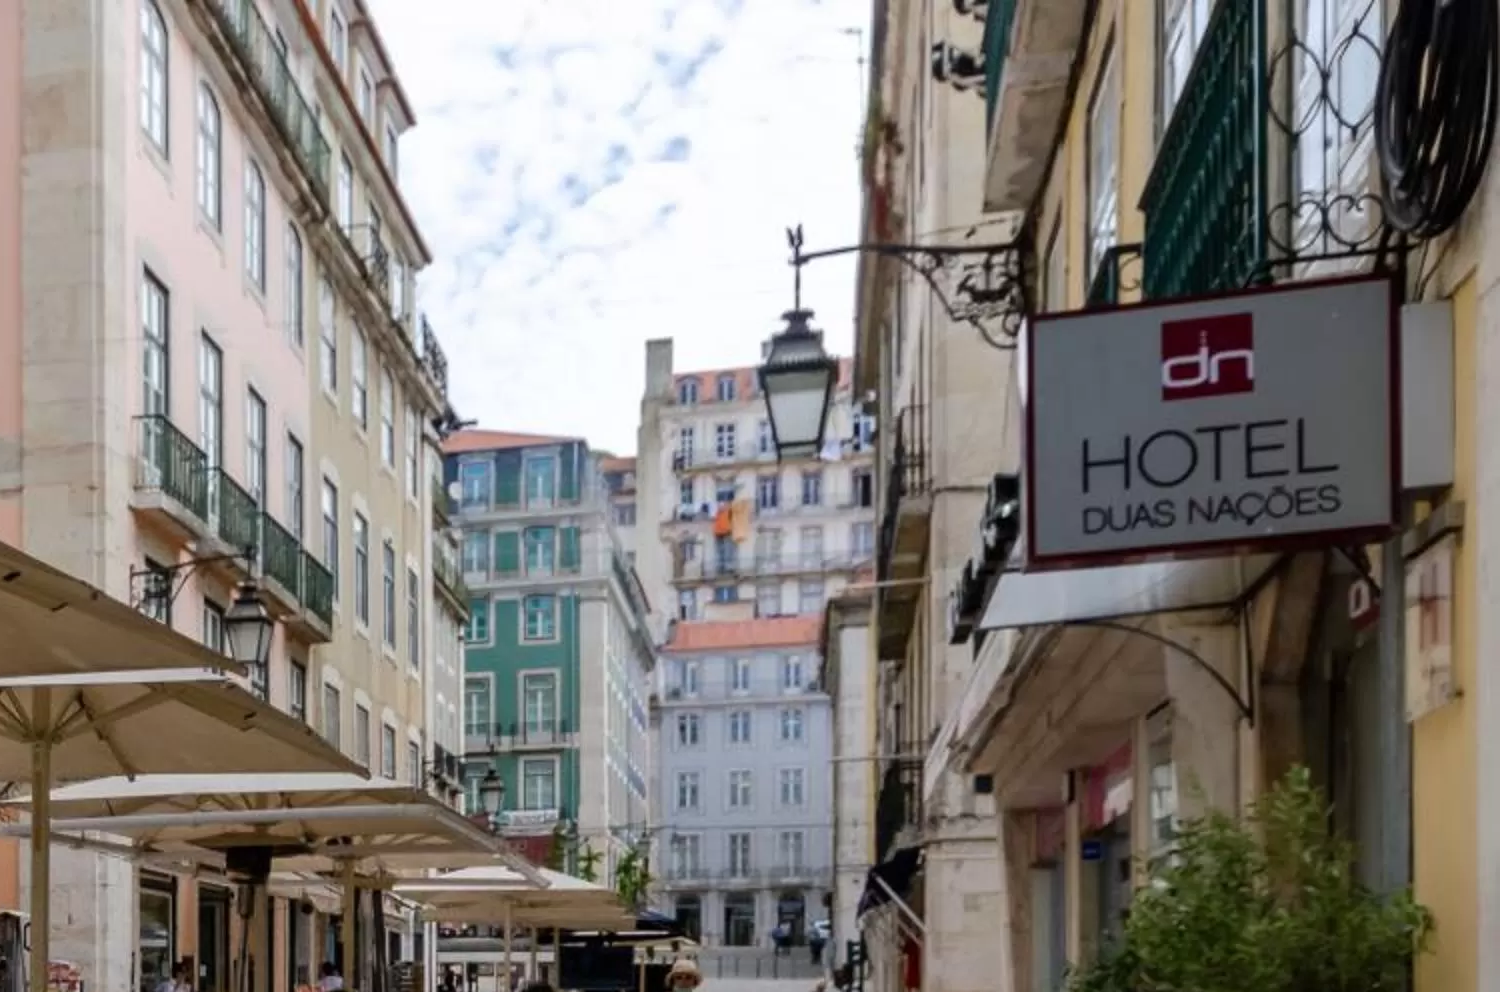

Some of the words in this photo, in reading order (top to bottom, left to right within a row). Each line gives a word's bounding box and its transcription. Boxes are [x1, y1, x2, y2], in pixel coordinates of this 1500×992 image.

[1081, 417, 1339, 494] HOTEL
[1082, 500, 1177, 535] DUAS
[1187, 484, 1341, 526] NAÇÕES
